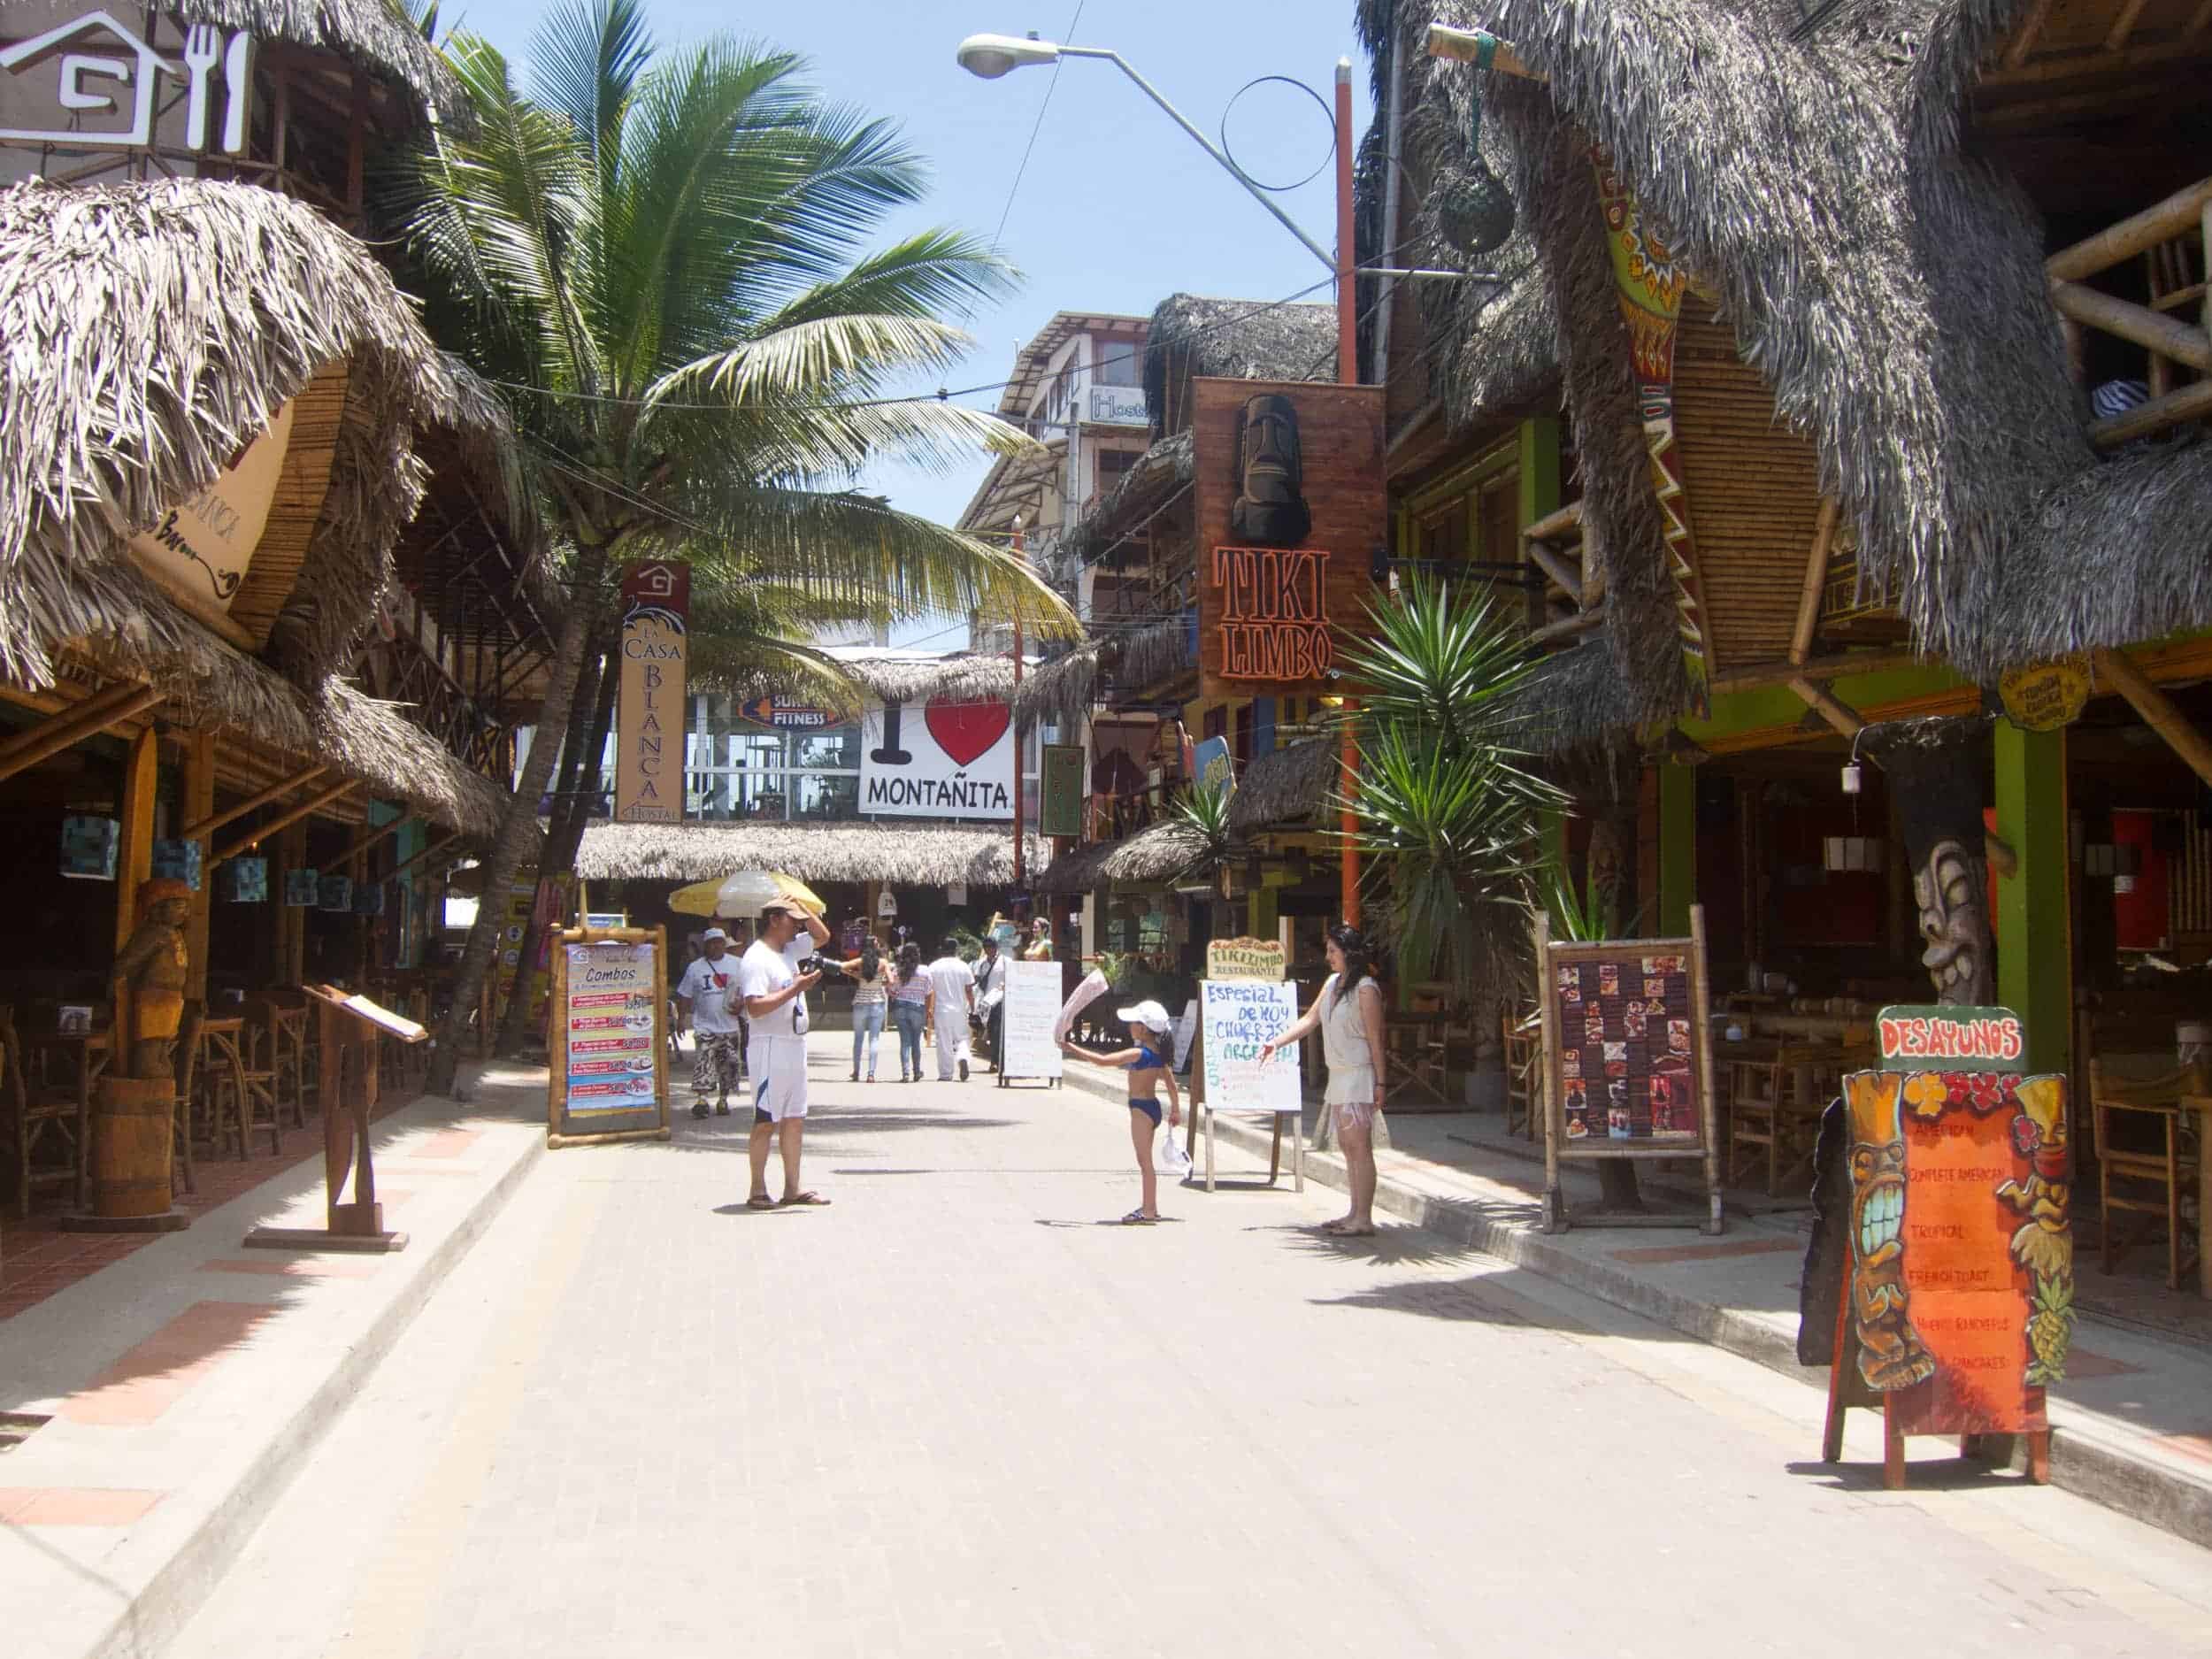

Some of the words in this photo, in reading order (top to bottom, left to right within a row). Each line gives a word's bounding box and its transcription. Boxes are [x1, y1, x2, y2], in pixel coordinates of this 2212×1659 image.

[1213, 546, 1331, 625] TIKI
[1218, 622, 1333, 680] LIMBO
[638, 664, 664, 799] BLANCA
[773, 711, 826, 726] FITNESS
[870, 697, 913, 765] I
[867, 772, 1009, 810] MONTAÑITA
[586, 966, 637, 984] Combos
[1878, 1017, 2023, 1059] DESAYUNOS
[1916, 1124, 1975, 1137] AMERICAN
[1909, 1167, 1955, 1183] COMPLETE
[1909, 1268, 1953, 1283] FRENCH
[1954, 1268, 1989, 1282] TOAST
